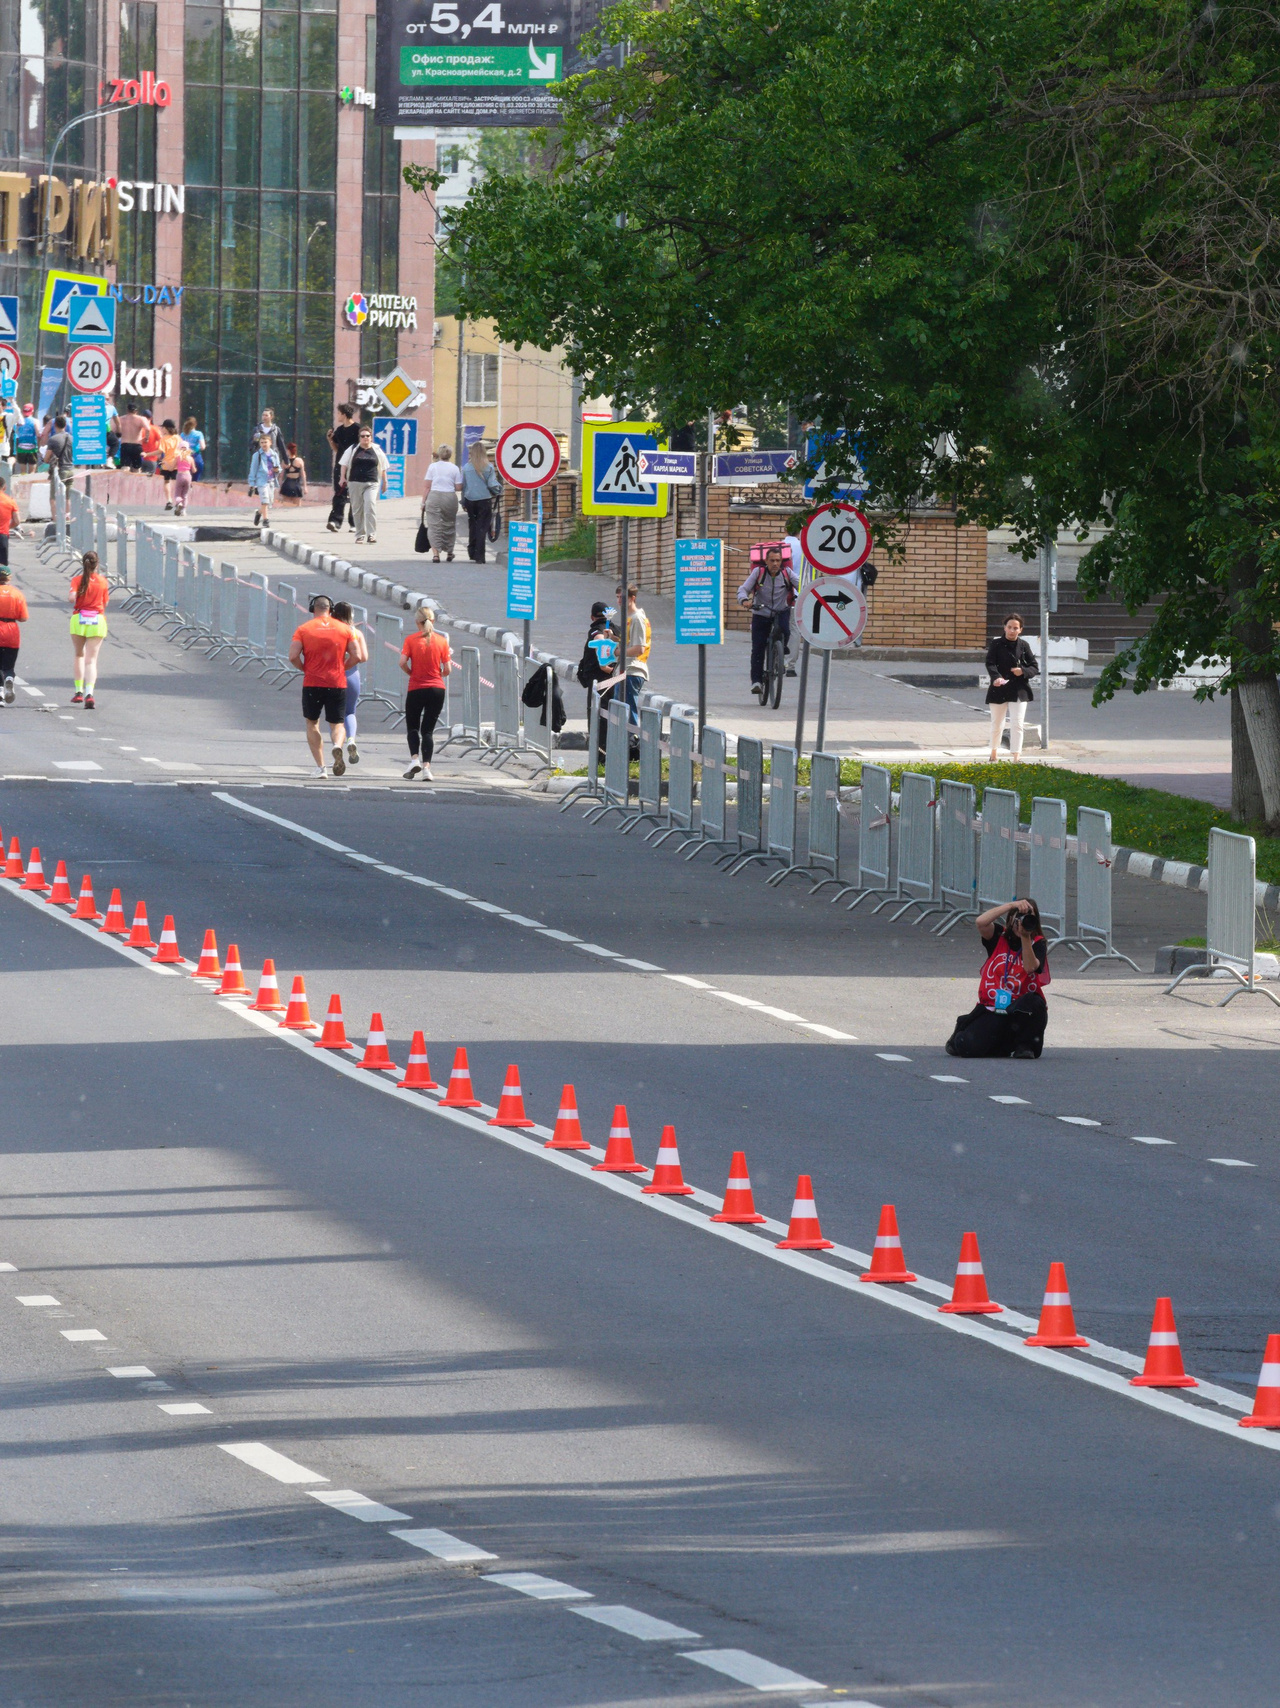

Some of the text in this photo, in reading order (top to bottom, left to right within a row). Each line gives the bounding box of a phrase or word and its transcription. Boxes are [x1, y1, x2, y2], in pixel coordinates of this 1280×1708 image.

[429, 3, 506, 40] 5,4
[411, 54, 495, 66] Офис продаж:
[411, 68, 522, 78] ул. Красноармейская, д.2
[110, 70, 172, 107] zolla
[369, 294, 418, 310] АПТЕКА
[369, 310, 418, 330] РИГЛА
[78, 360, 102, 379] 20
[120, 360, 173, 398] kari
[511, 443, 544, 468] 20
[664, 457, 678, 465] Улица
[744, 457, 763, 465] Улица
[734, 465, 773, 473] СОВЕТСКАЯ
[818, 525, 856, 553] 20
